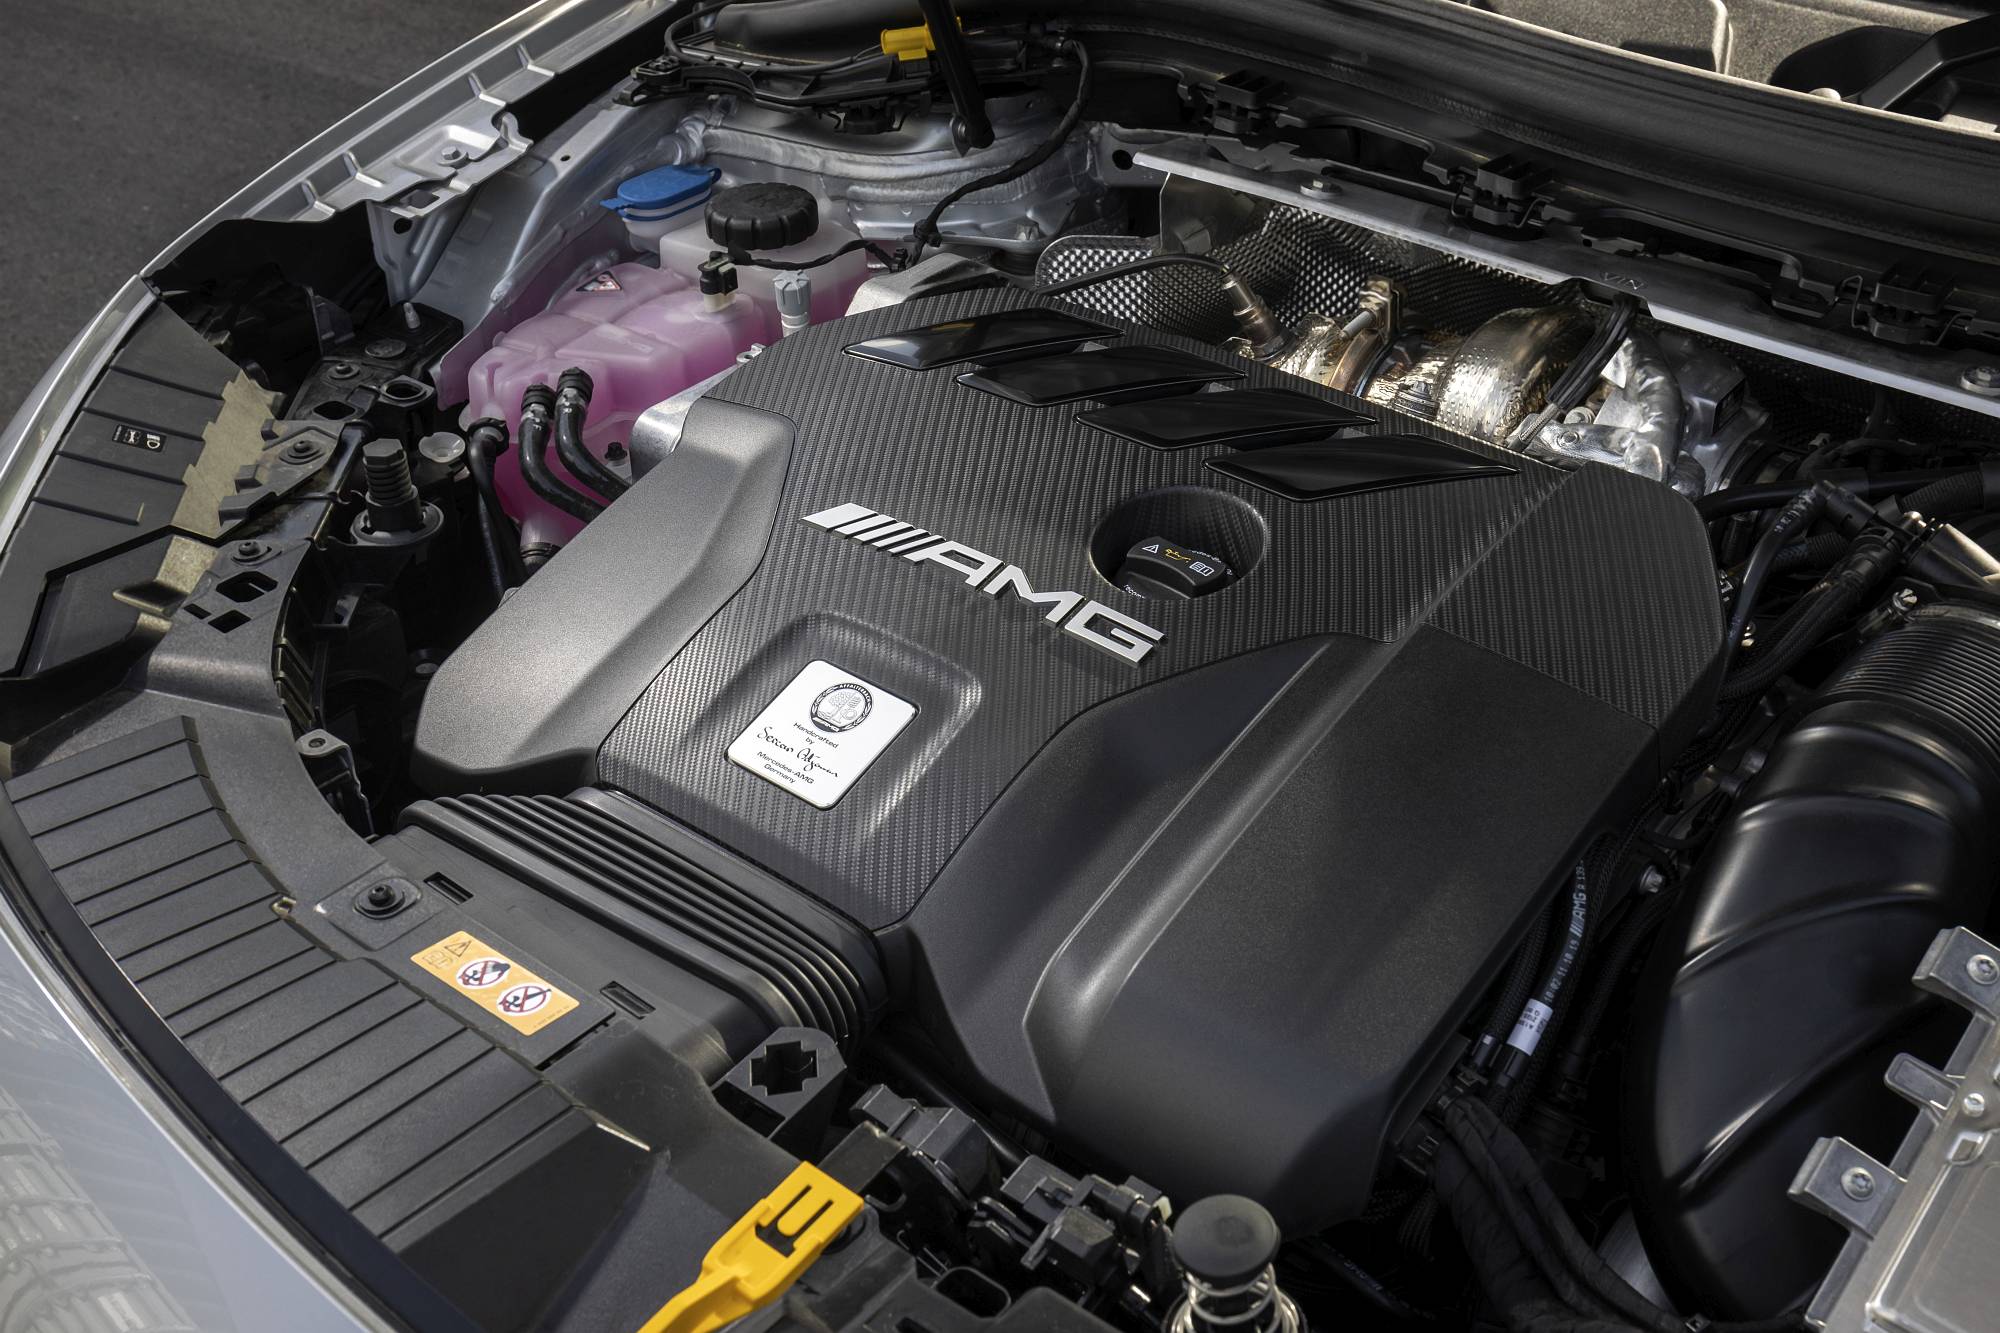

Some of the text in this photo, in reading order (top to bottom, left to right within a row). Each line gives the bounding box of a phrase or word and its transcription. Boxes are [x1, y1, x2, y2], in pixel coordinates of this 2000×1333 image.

[910, 539, 1165, 668] AMG
[793, 722, 839, 748] Handcrafted
[805, 737, 815, 745] by
[757, 751, 815, 784] Mercedes-AMG
[764, 763, 796, 784] Germany
